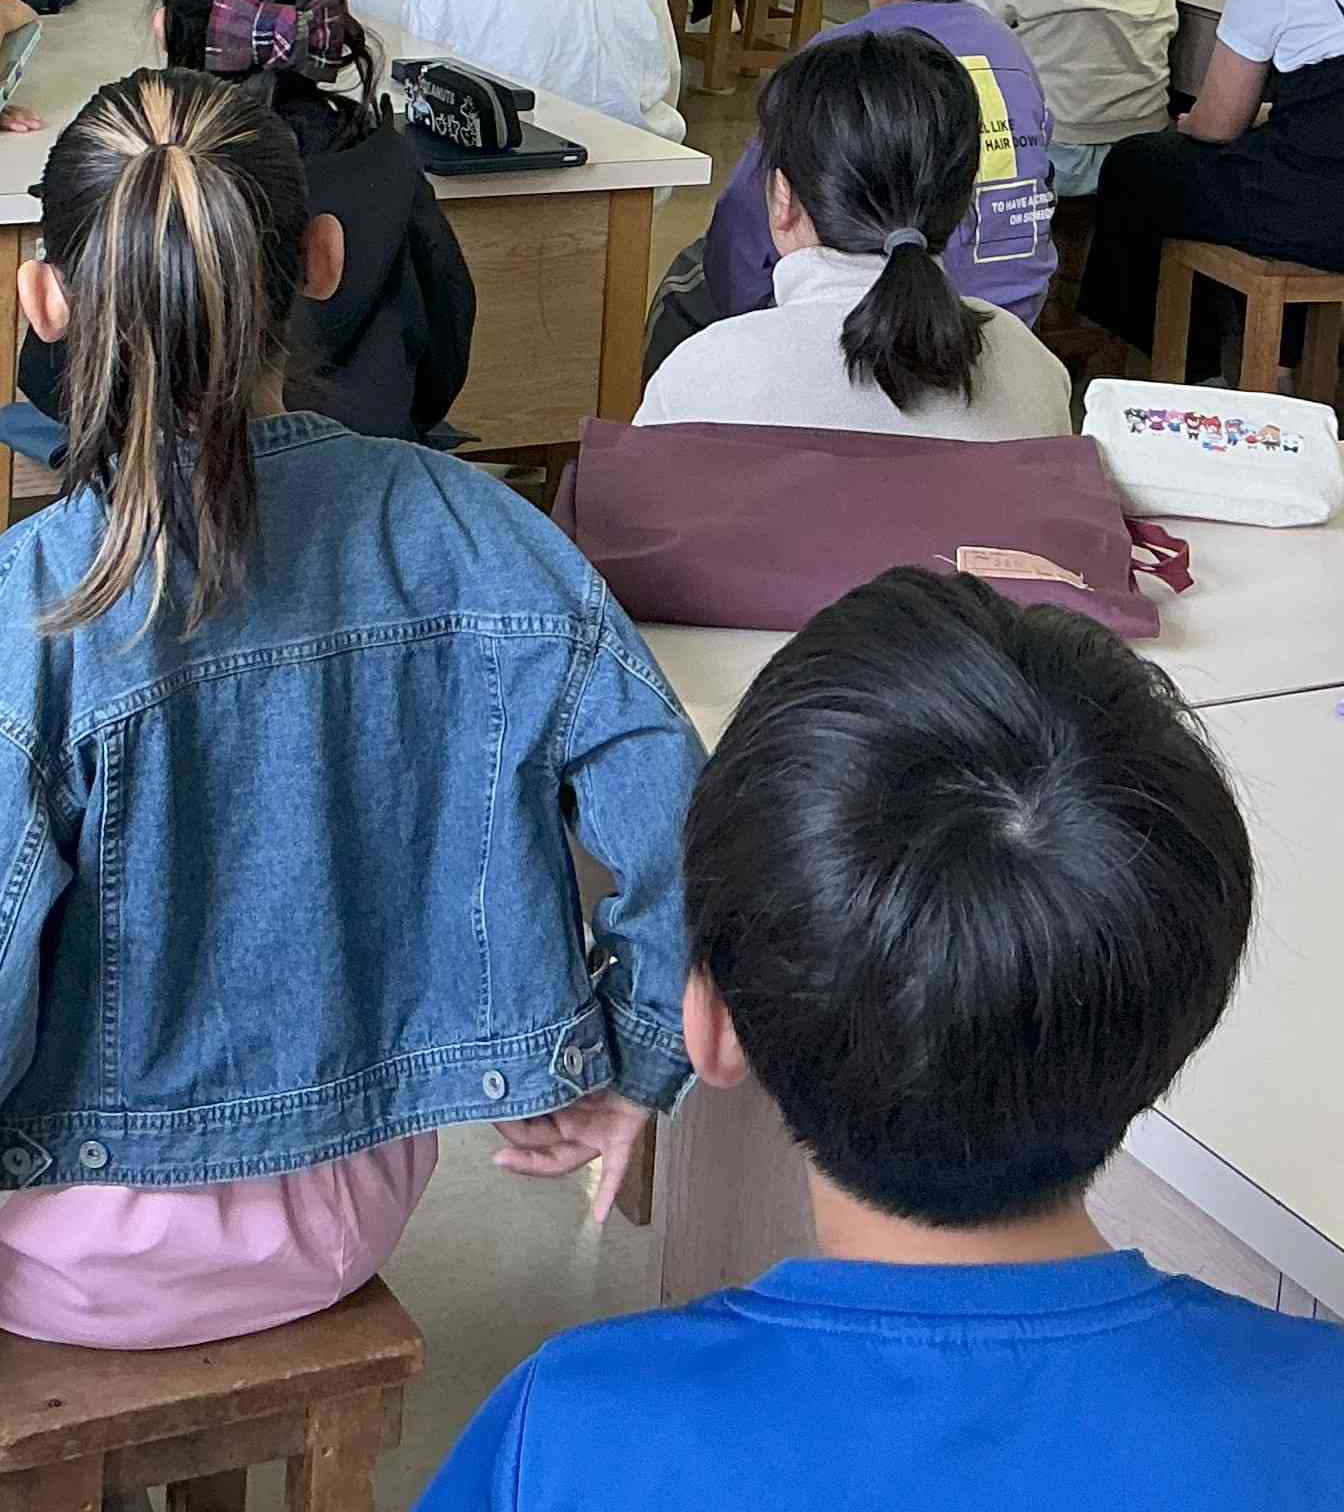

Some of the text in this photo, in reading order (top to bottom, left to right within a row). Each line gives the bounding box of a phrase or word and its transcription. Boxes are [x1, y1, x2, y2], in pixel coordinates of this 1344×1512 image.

[990, 118, 1015, 133] LIKE
[984, 138, 1010, 151] HAIR
[992, 201, 1005, 213] TO
